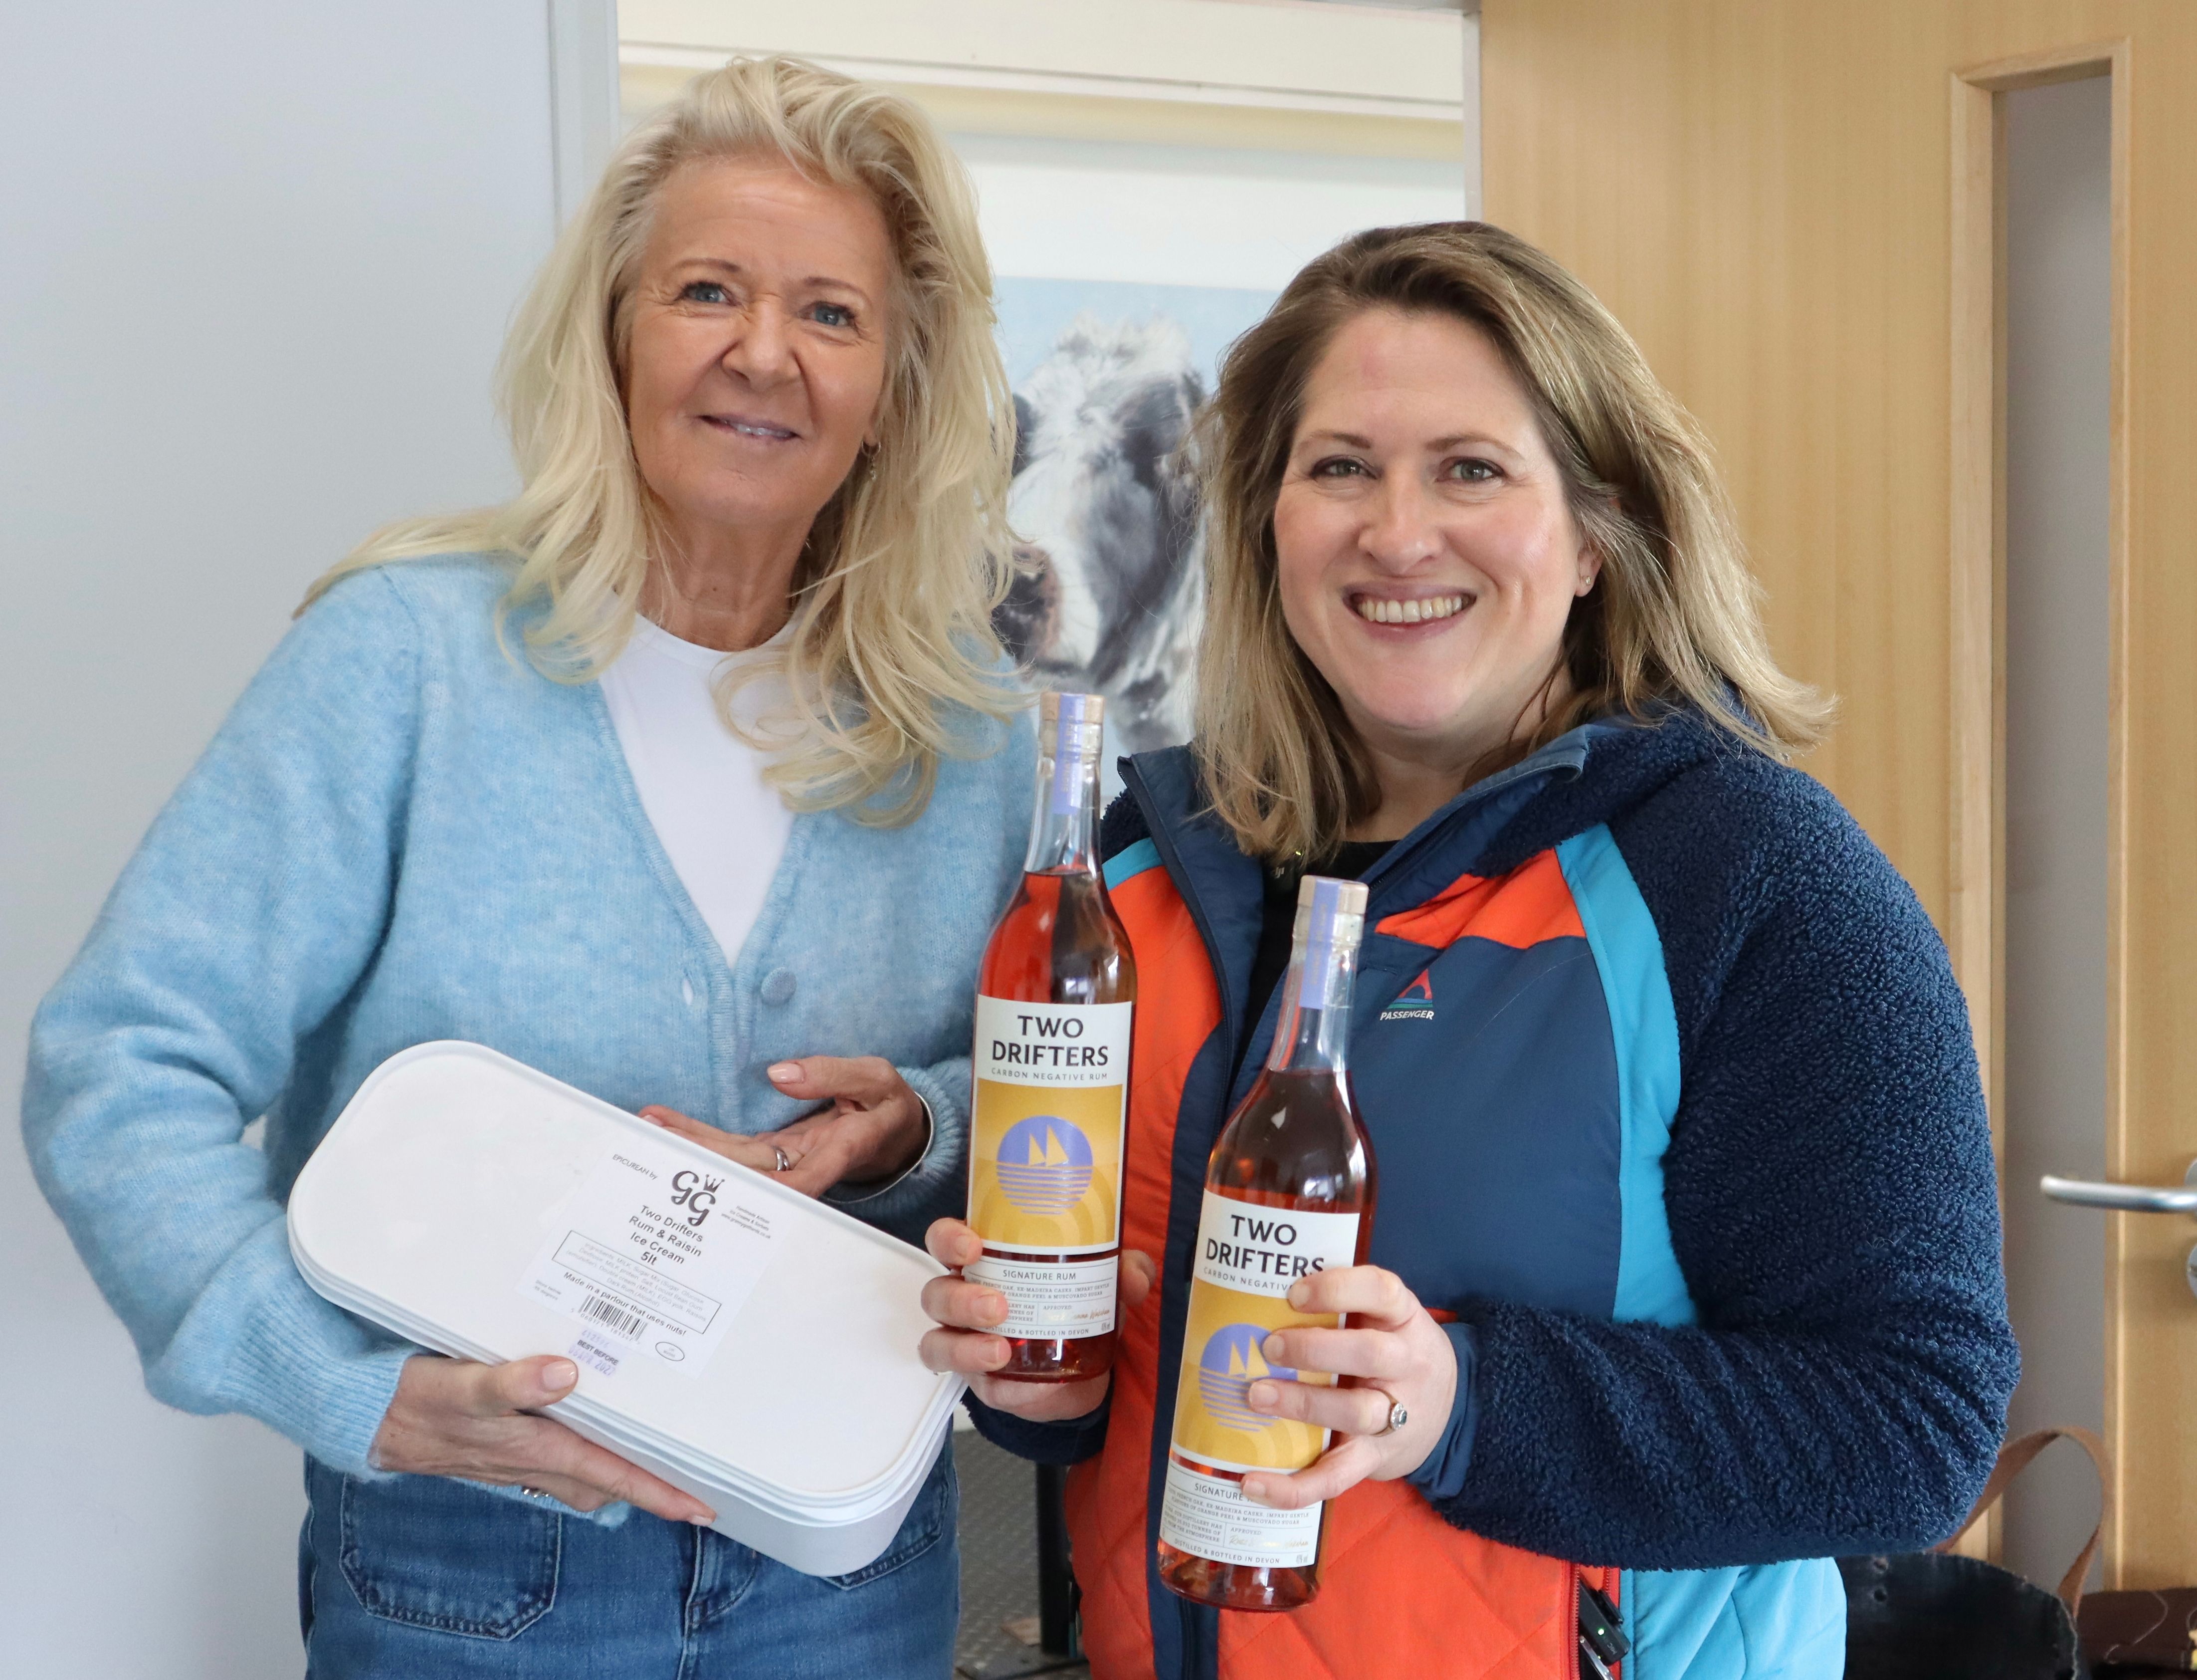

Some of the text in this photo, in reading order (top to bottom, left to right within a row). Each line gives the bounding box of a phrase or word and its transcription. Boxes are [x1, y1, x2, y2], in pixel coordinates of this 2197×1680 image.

[1380, 1010, 1434, 1021] PASSENGER
[1017, 1015, 1083, 1038] TWO
[992, 1040, 1108, 1066] DRIFTERS
[992, 1067, 1028, 1078] CARBON
[613, 1154, 649, 1174] EPICUREAN
[640, 1206, 704, 1242] Two Drifters
[1231, 1214, 1297, 1246] TWO
[629, 1216, 703, 1256] Rum & Raisin
[631, 1232, 685, 1263] Ice Cream
[641, 1251, 658, 1264] 5lt
[1205, 1238, 1325, 1277] DRIFTERS
[1003, 1269, 1053, 1280] SIGNATURE
[1203, 1267, 1235, 1282] CARBON
[564, 1272, 585, 1285] Made
[601, 1291, 629, 1308] parlour
[630, 1305, 646, 1315] that
[646, 1314, 665, 1326] uses
[667, 1323, 686, 1335] nuts!
[578, 1340, 618, 1364] BEST BEFORE
[1195, 1483, 1243, 1501] SIGNATURE
[1198, 1507, 1218, 1516] ORANGE
[1186, 1529, 1219, 1542] ATMOSPHERE
[1192, 1524, 1212, 1534] TONNES
[1230, 1527, 1261, 1535] APPROVED
[1174, 1538, 1201, 1552] DISTILLED
[1210, 1550, 1242, 1561] BOTTLED
